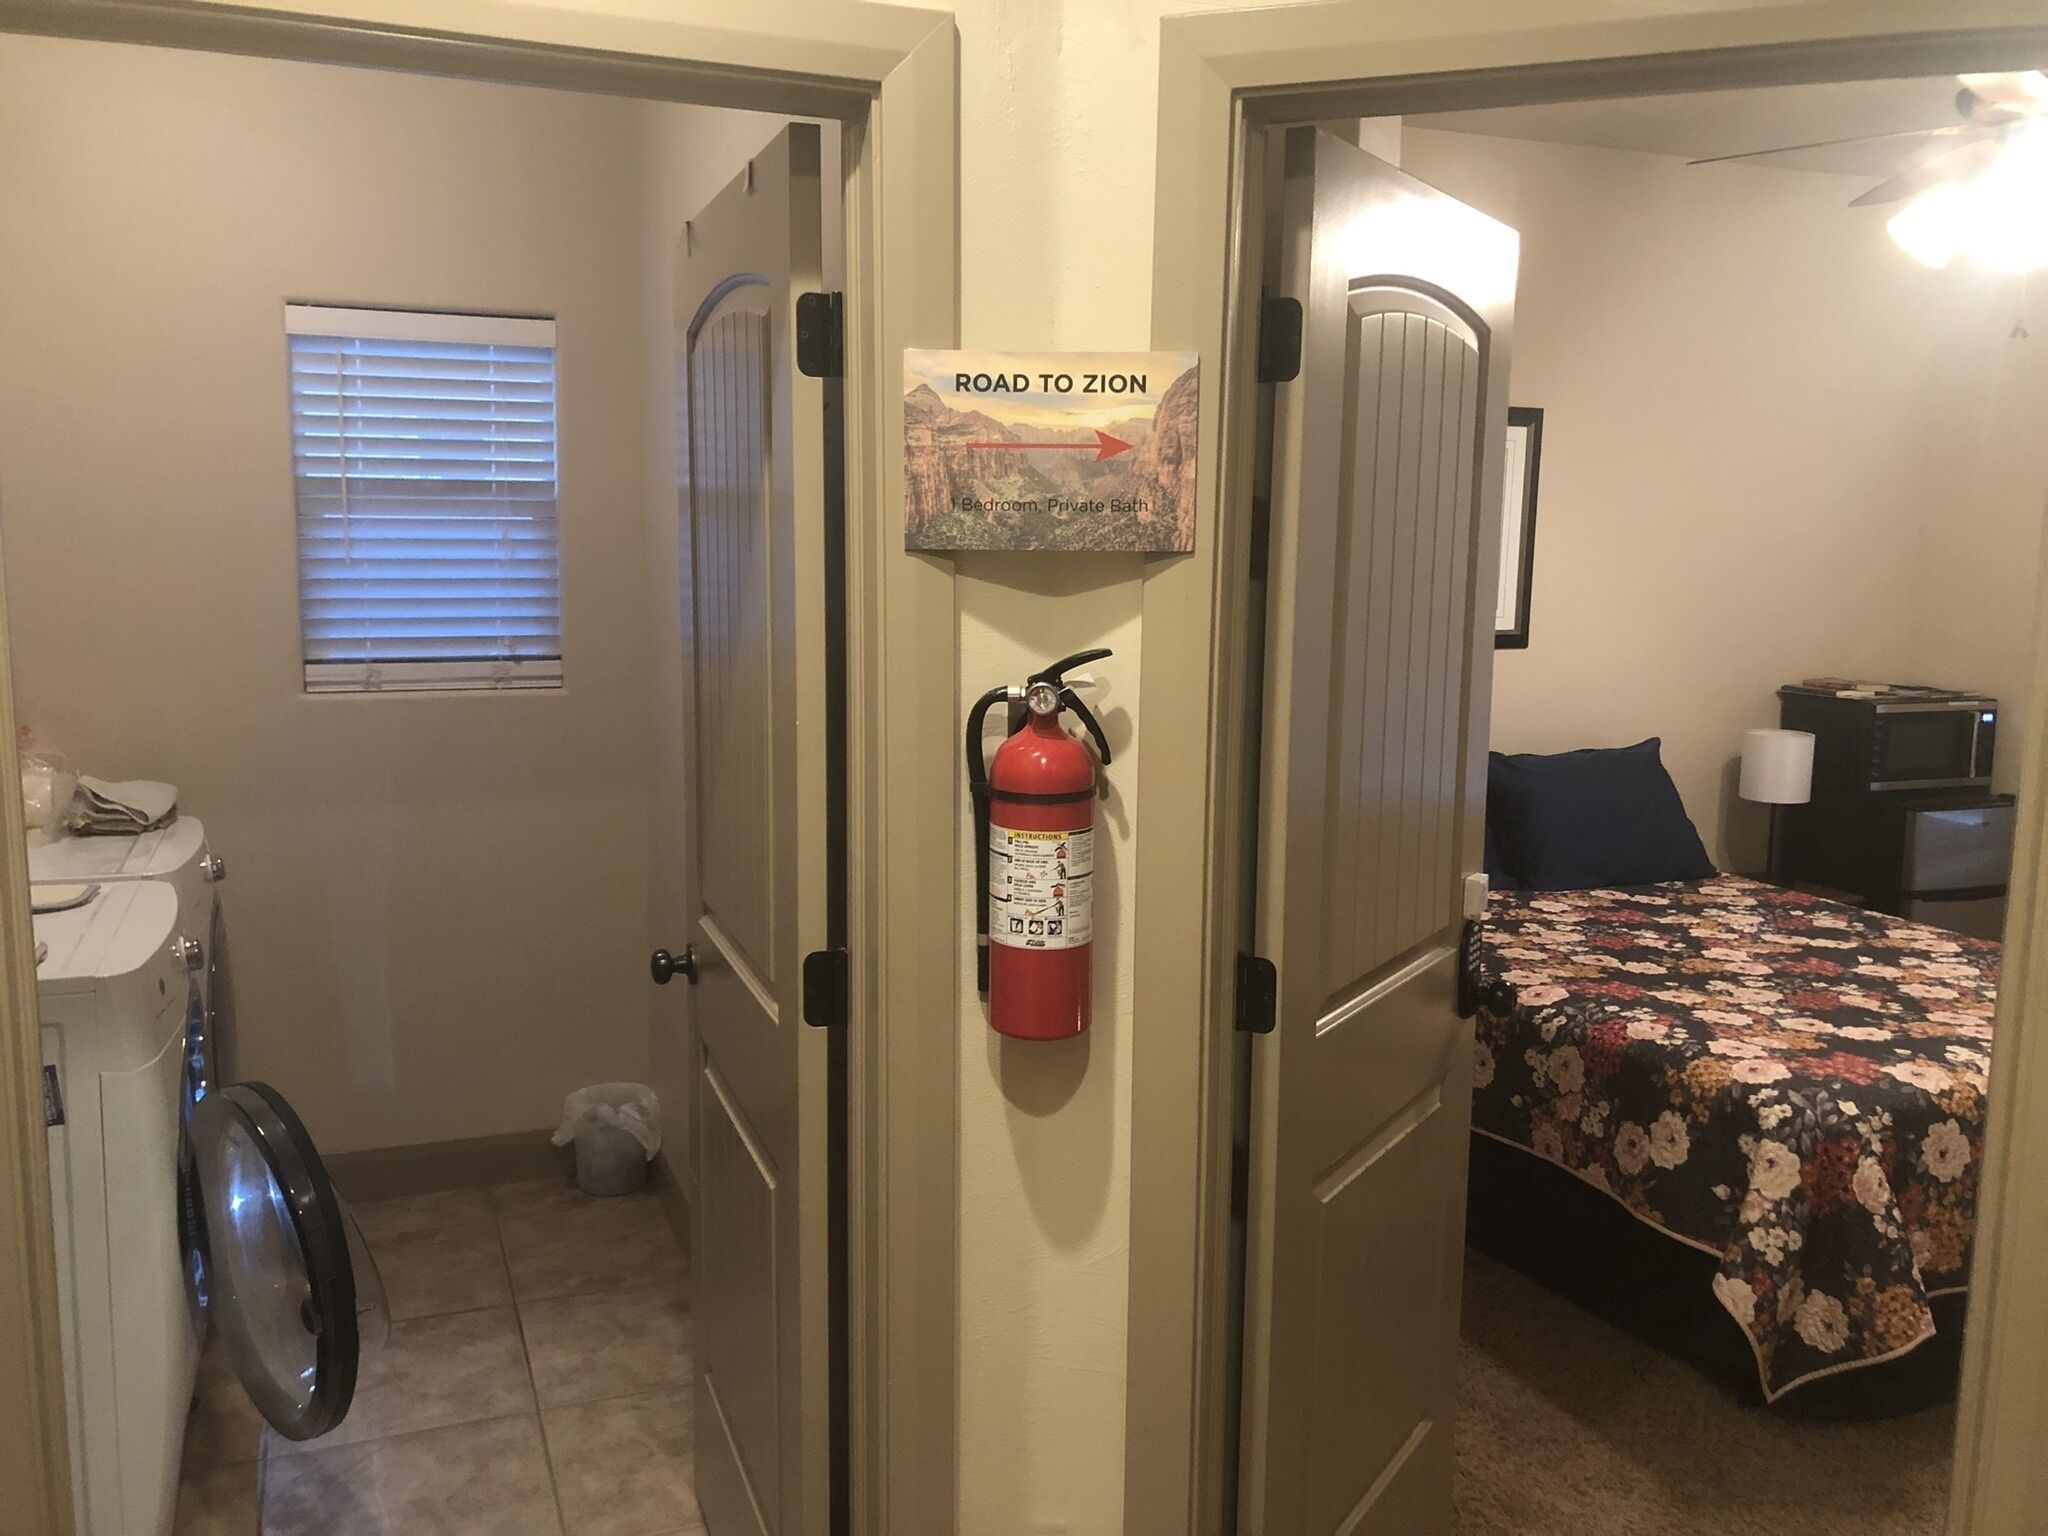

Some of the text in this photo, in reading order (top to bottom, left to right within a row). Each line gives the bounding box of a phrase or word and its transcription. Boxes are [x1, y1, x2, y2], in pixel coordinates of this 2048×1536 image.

[955, 373, 1147, 393] ROAD TO ZION
[962, 498, 1042, 513] Bedroom,
[1048, 498, 1104, 513] Private
[1111, 498, 1148, 513] Bath
[1014, 832, 1062, 840] INSTRUCTIONS
